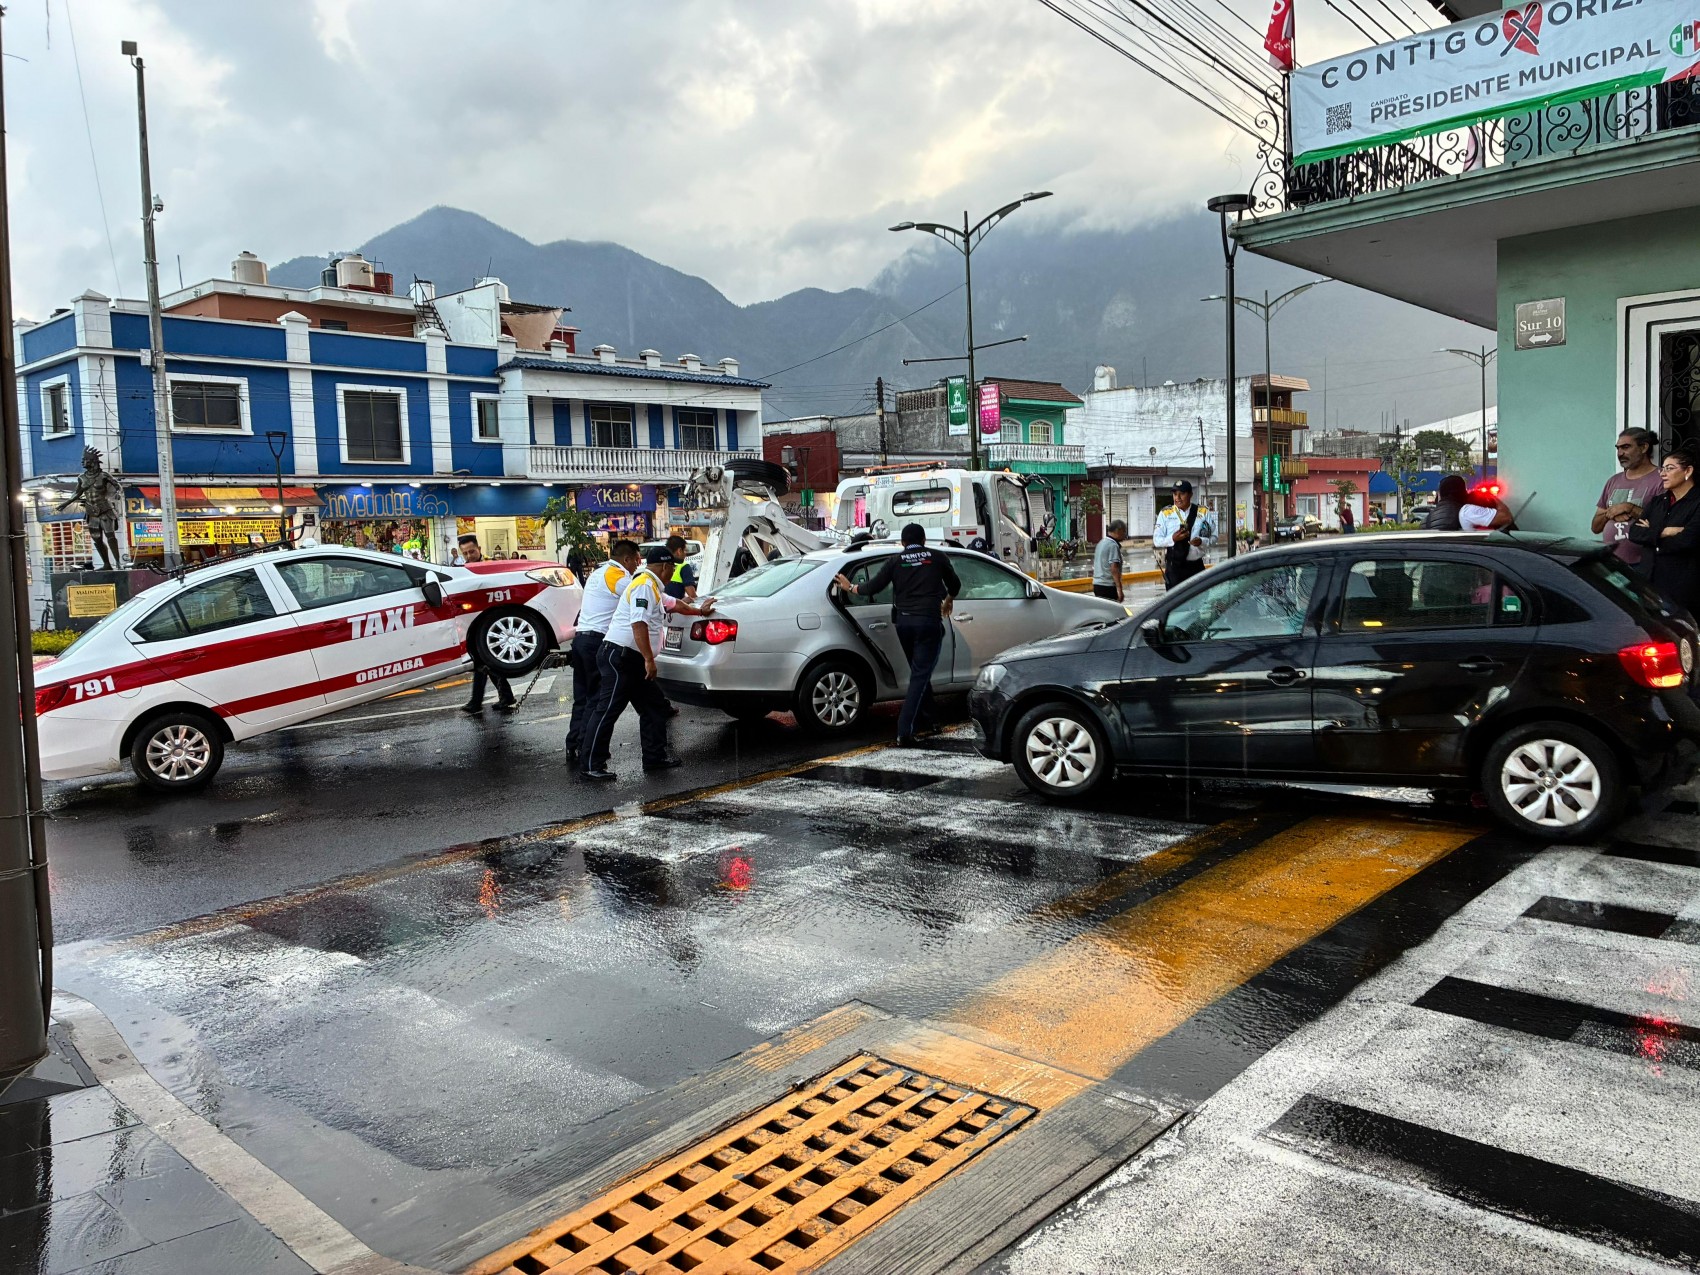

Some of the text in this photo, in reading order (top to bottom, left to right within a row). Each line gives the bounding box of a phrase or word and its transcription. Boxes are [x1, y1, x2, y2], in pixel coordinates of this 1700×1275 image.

[1321, 22, 1499, 89] CONTIGO
[1370, 38, 1661, 124] PRESIDENTE MUNICIPAL
[1370, 93, 1409, 108] CANDIDATO
[1519, 315, 1562, 332] Sur 10
[126, 498, 149, 514] EL
[603, 488, 643, 503] Katisa
[486, 589, 512, 603] 791
[347, 605, 415, 640] TAXI
[355, 657, 425, 684] ORIZABA
[69, 674, 116, 701] 791
